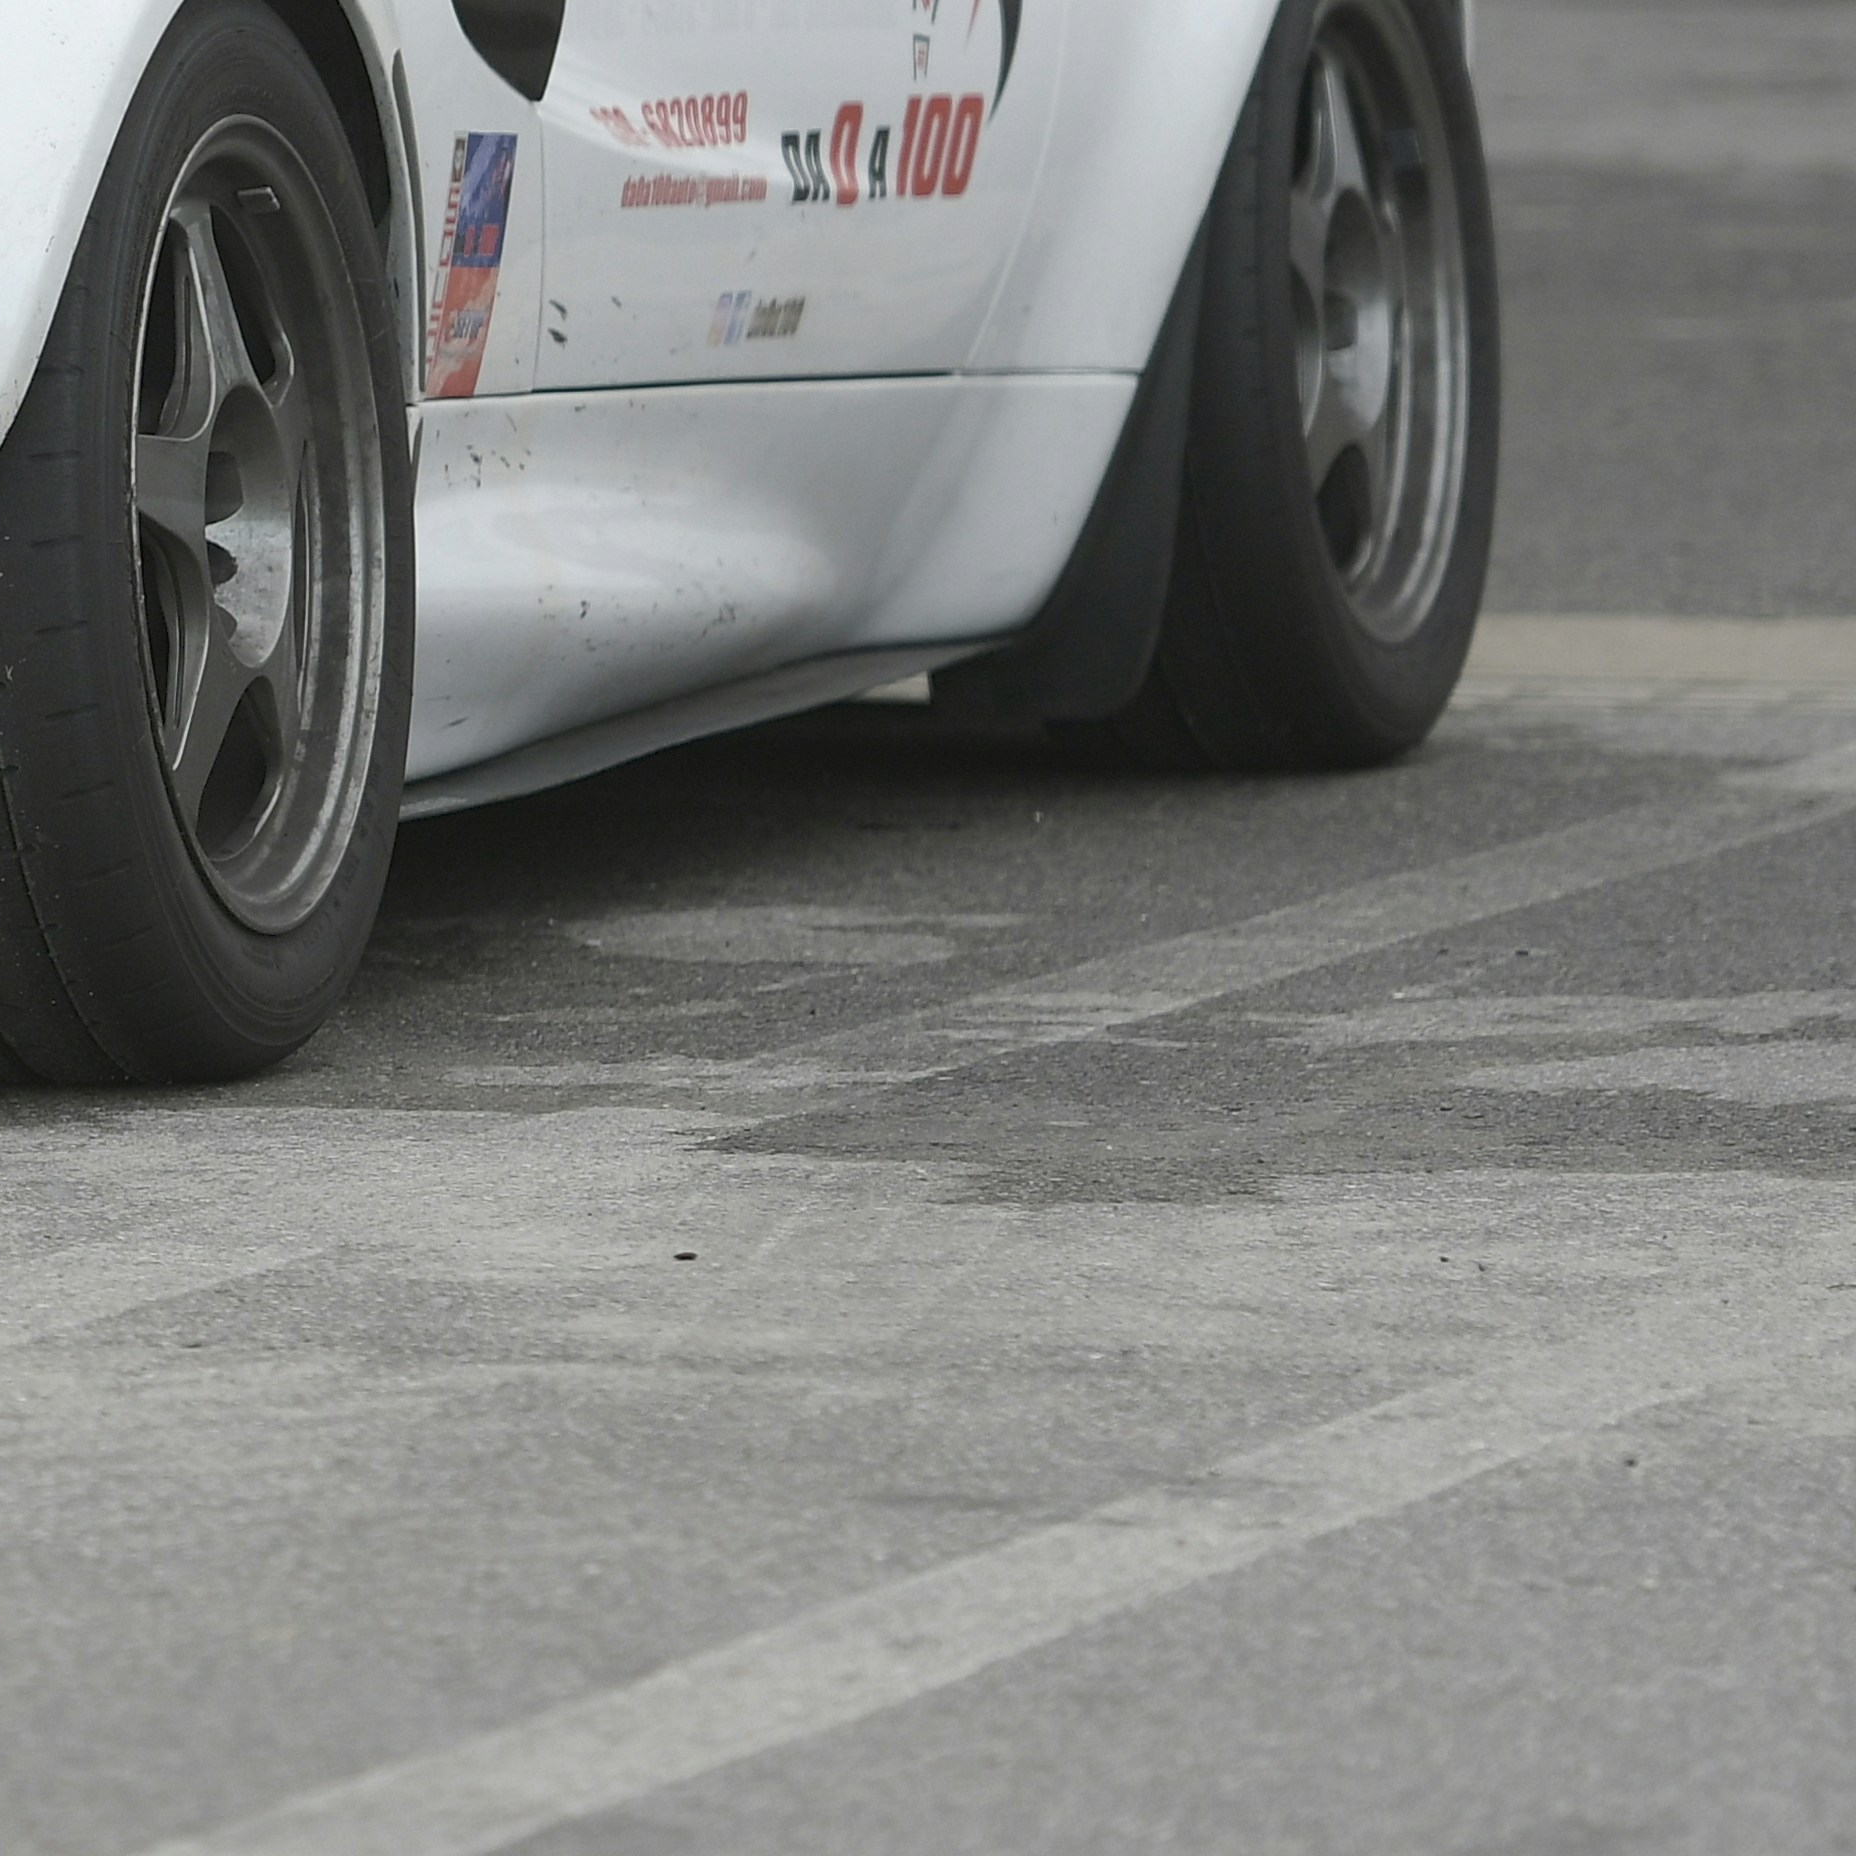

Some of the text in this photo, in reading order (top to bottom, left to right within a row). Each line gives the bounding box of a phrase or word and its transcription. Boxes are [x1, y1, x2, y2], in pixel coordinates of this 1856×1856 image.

[782, 127, 830, 204] DA
[868, 124, 891, 202] A
[896, 91, 985, 201] 100
